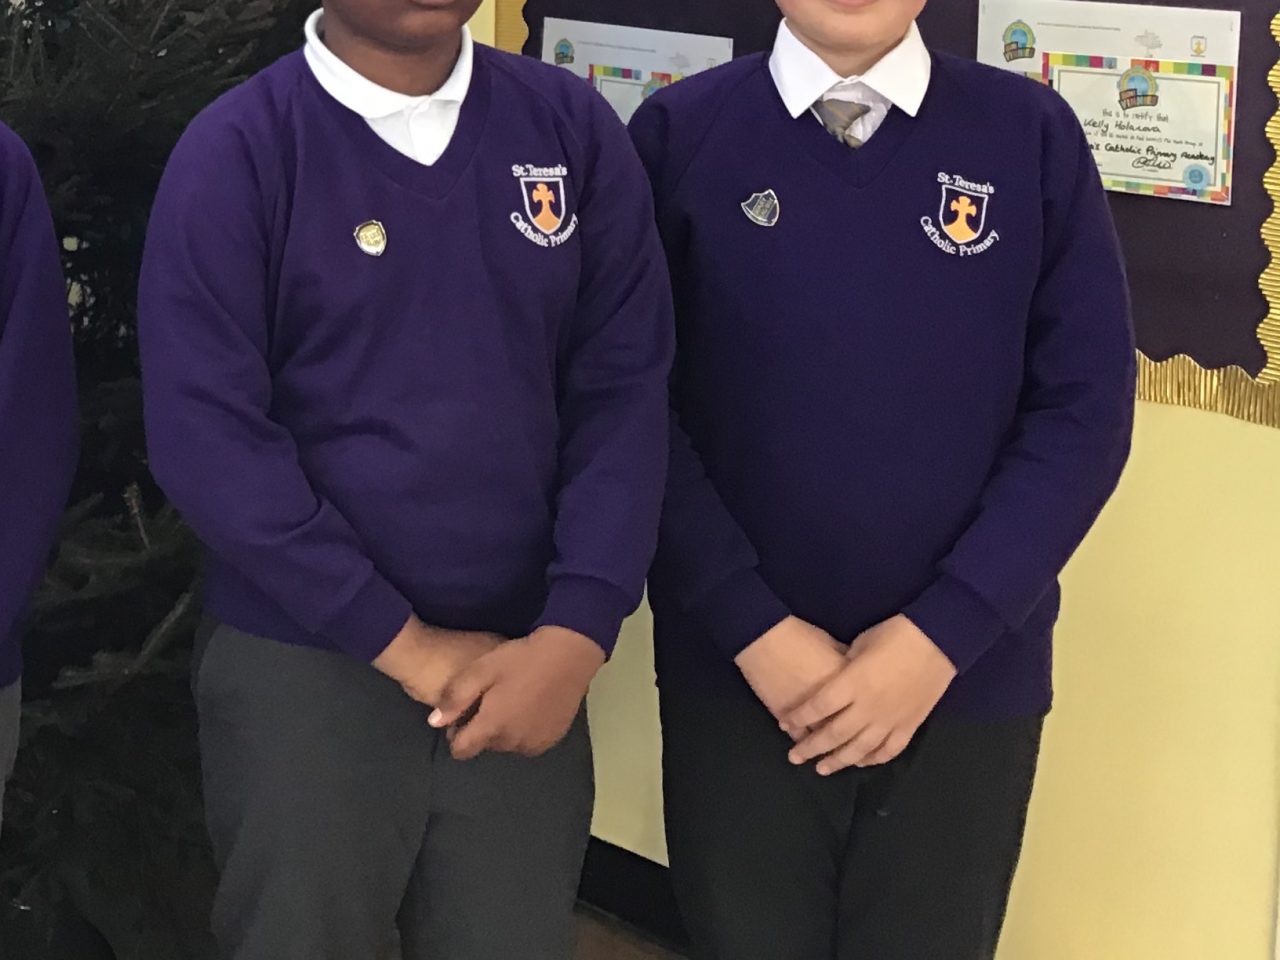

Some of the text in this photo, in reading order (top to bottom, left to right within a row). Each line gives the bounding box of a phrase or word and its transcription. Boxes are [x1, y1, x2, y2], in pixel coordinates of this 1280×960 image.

[1104, 142, 1142, 155] Catholic
[526, 164, 568, 176] Teresa's
[953, 174, 995, 194] Teresa's
[509, 211, 579, 248] Catholic Primary
[920, 216, 1000, 257] Catholic Primary
